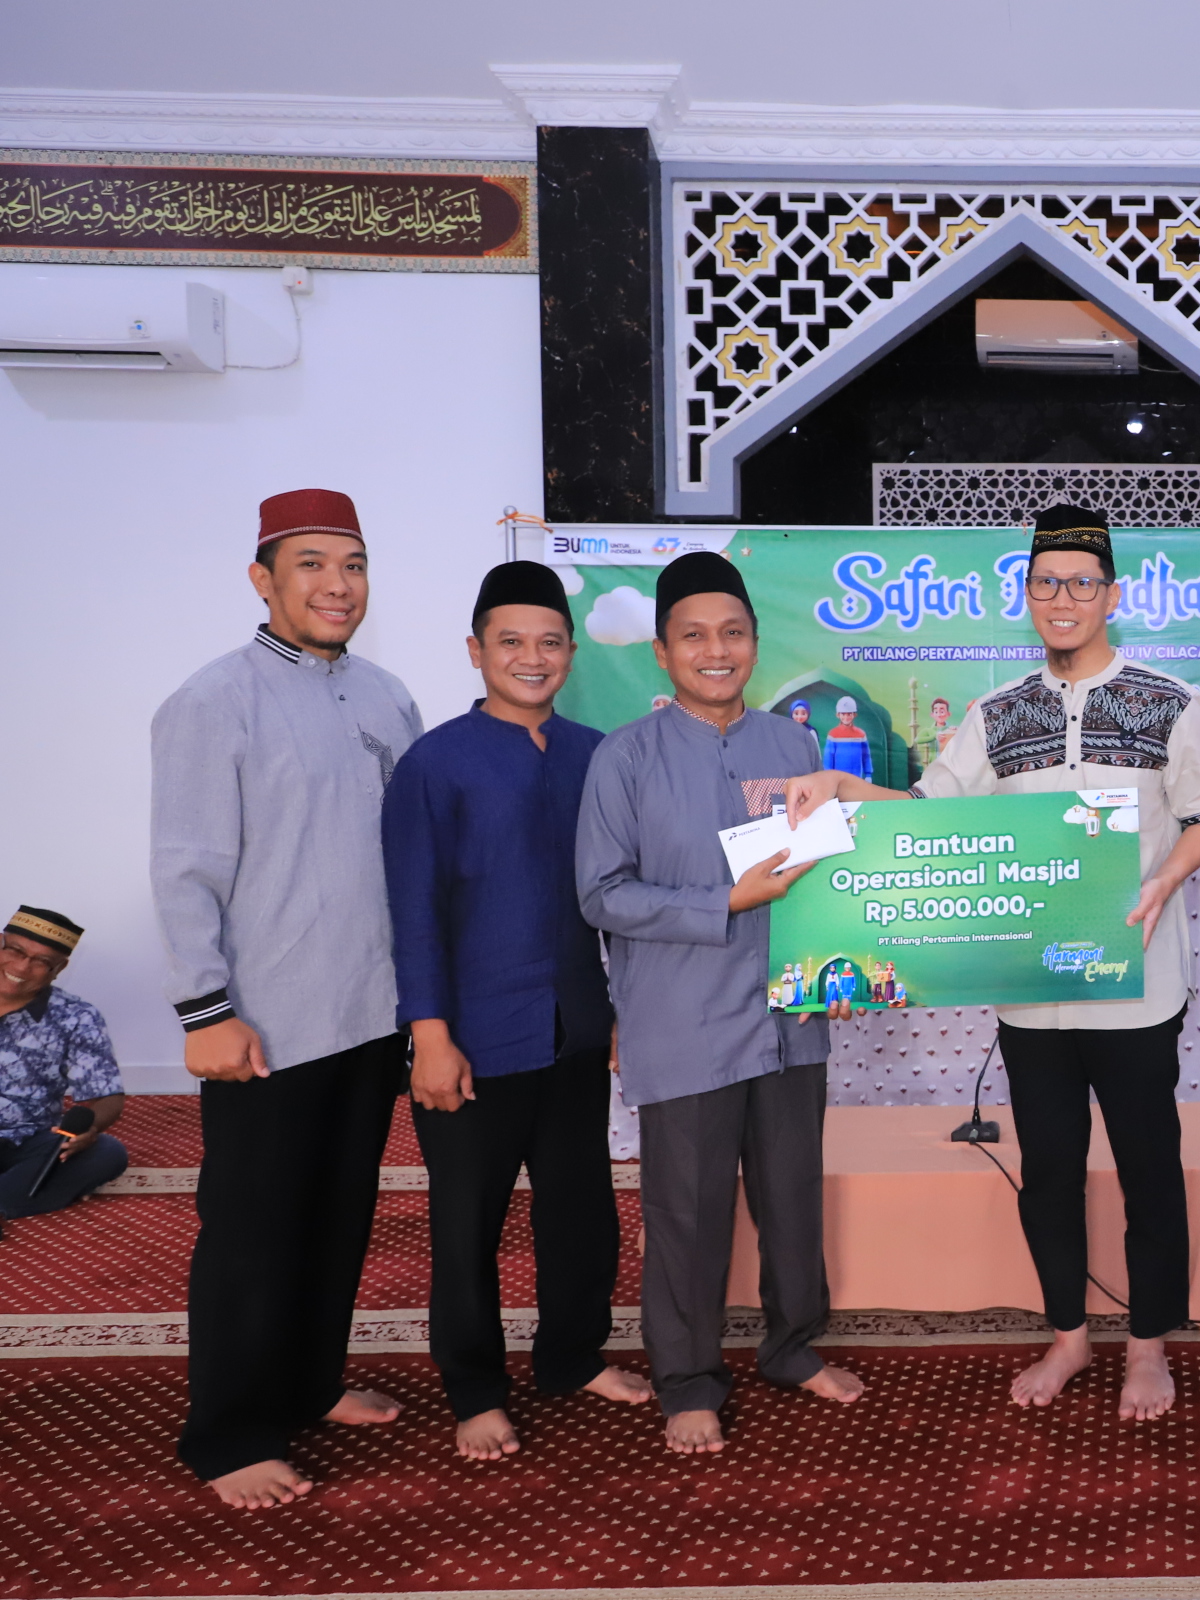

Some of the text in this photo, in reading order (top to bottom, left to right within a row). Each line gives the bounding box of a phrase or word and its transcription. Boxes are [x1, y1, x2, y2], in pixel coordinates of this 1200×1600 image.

[814, 551, 987, 633] Safari
[843, 647, 861, 660] PT
[864, 647, 917, 660] KILANG
[920, 647, 999, 660] PERTAMINA
[1139, 646, 1153, 659] IV
[894, 833, 1015, 858] Bantuan
[831, 858, 1080, 893] Operasional Masjid
[866, 895, 1045, 924] Rp 5.000.000,-
[891, 937, 921, 946] Kilang
[922, 935, 970, 944] Pertamina
[972, 931, 1032, 942] Internasional
[1042, 942, 1105, 971] Harmoni
[1084, 960, 1129, 983] Energi
